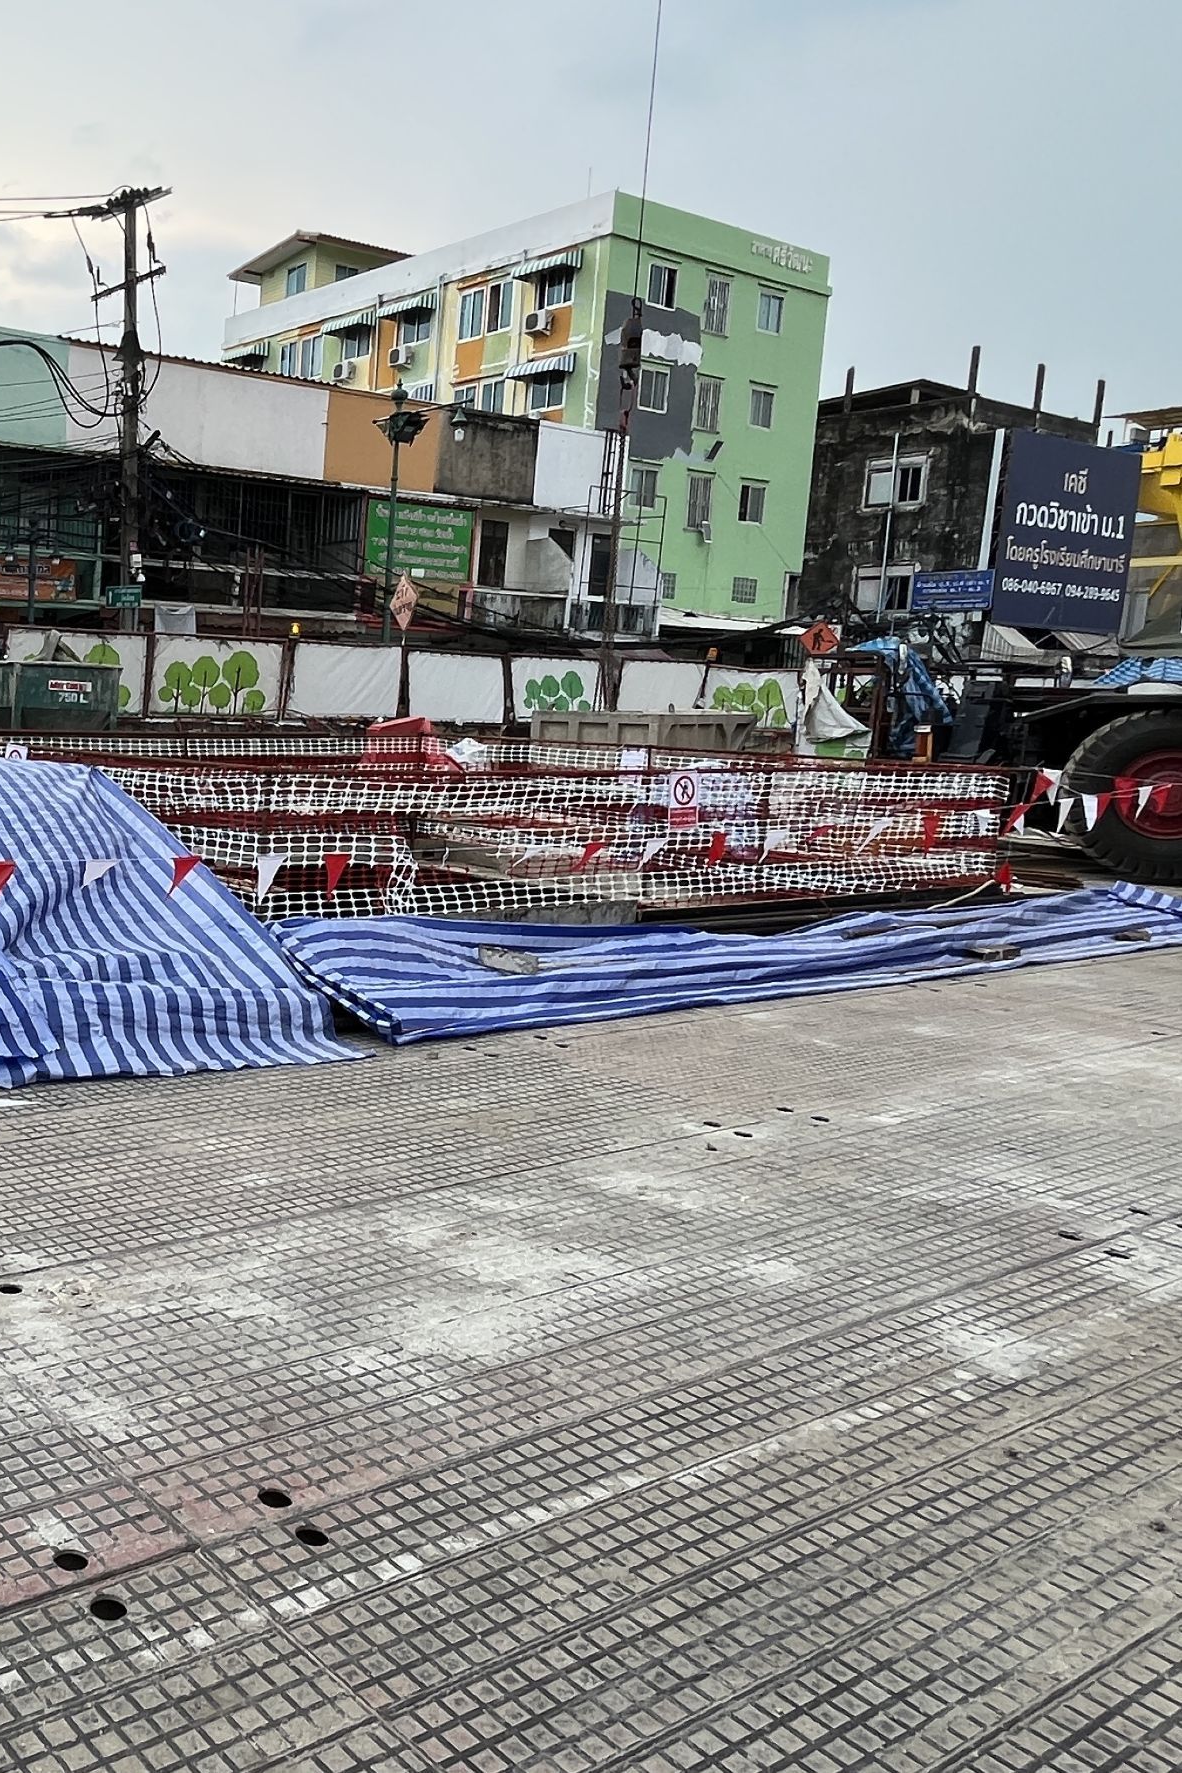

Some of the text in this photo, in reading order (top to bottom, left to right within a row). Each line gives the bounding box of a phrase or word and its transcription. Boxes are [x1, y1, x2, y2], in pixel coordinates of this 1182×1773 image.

[1015, 501, 1125, 540] กวดวิชาเข้า ม.1
[58, 692, 89, 703] 750 L
